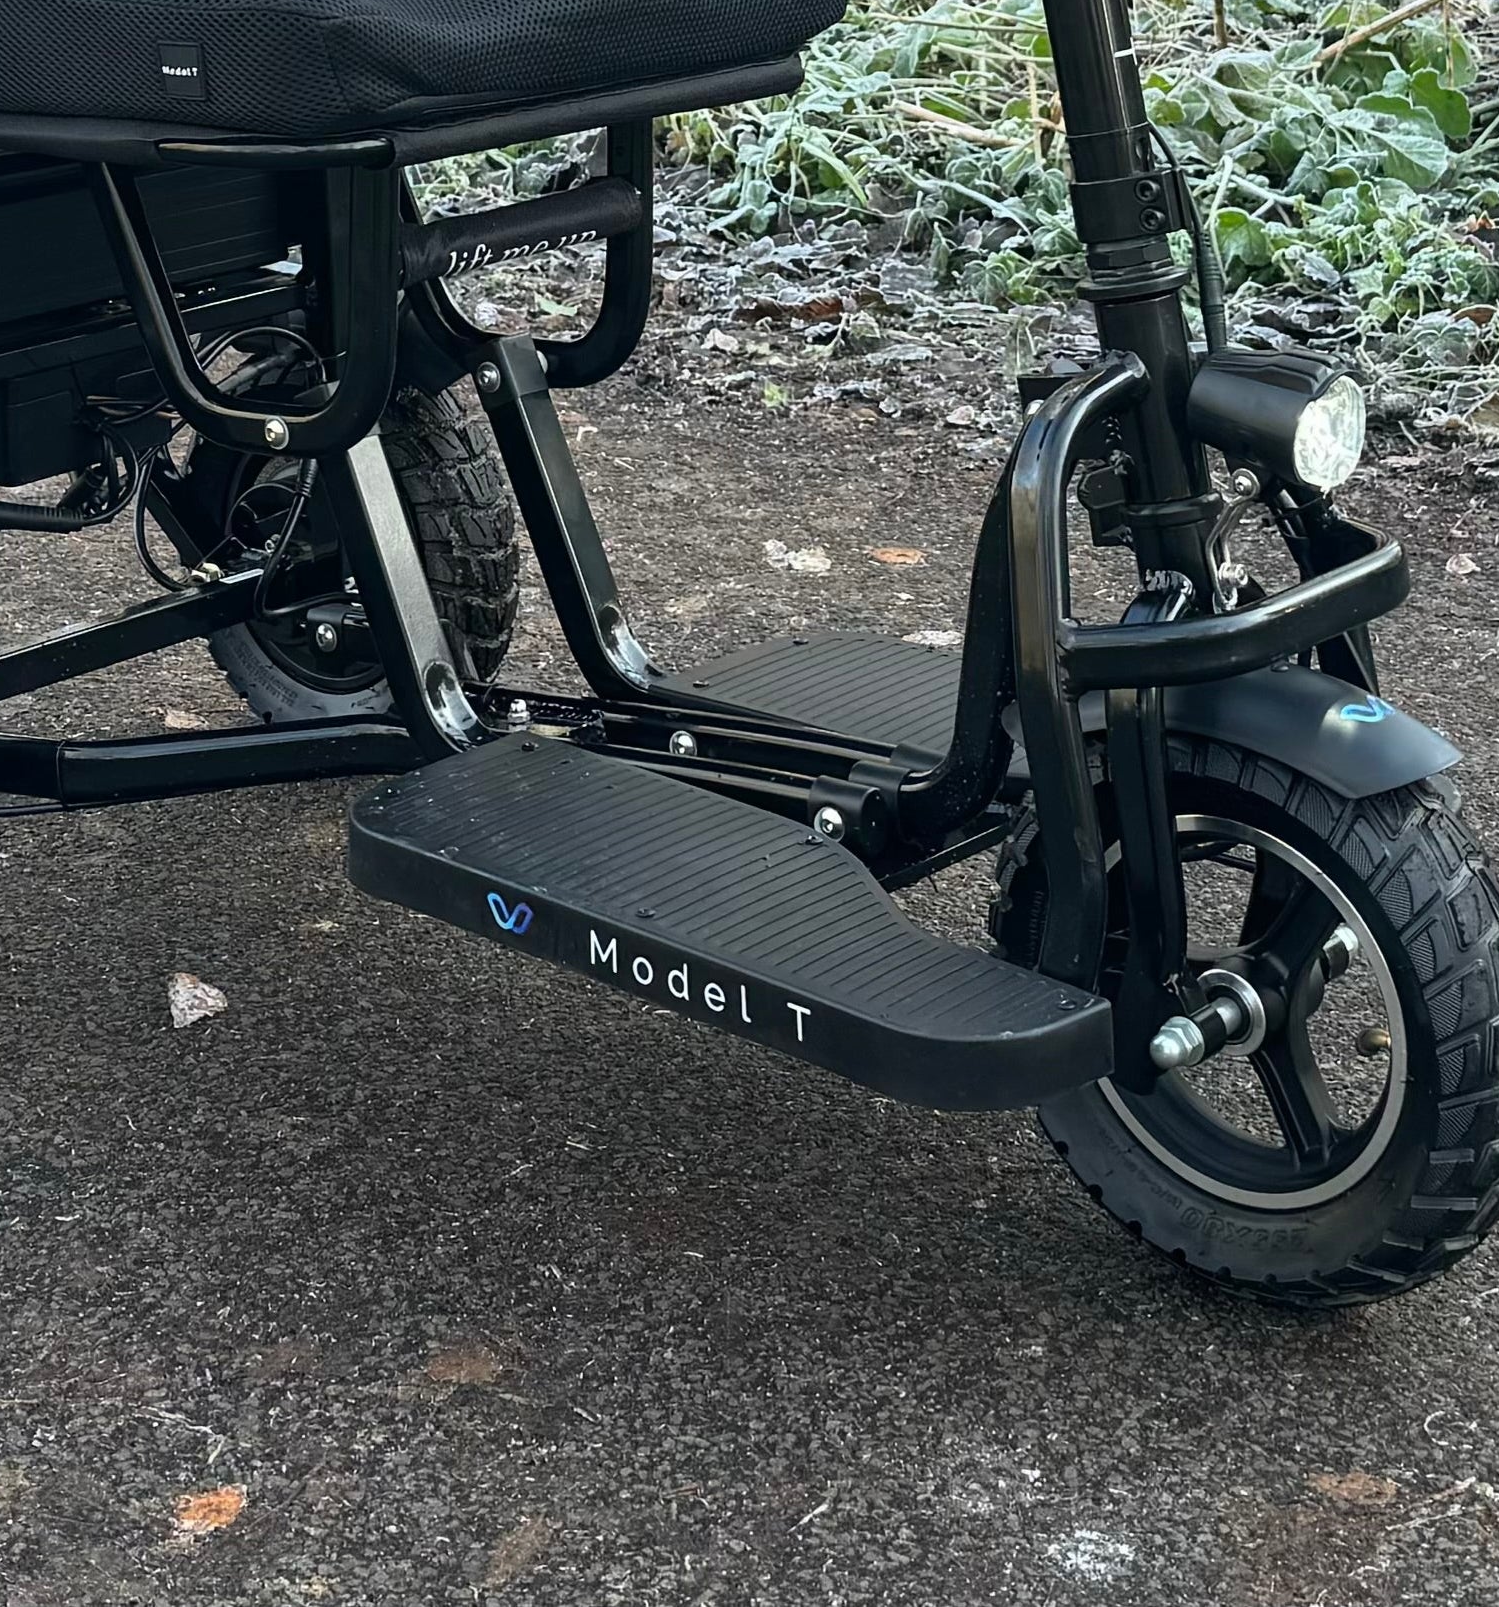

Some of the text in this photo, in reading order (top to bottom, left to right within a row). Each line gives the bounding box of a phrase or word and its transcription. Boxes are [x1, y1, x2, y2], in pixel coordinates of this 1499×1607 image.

[1113, 37, 1138, 66] T
[161, 65, 198, 77] Model T
[589, 929, 812, 1042] Model T
